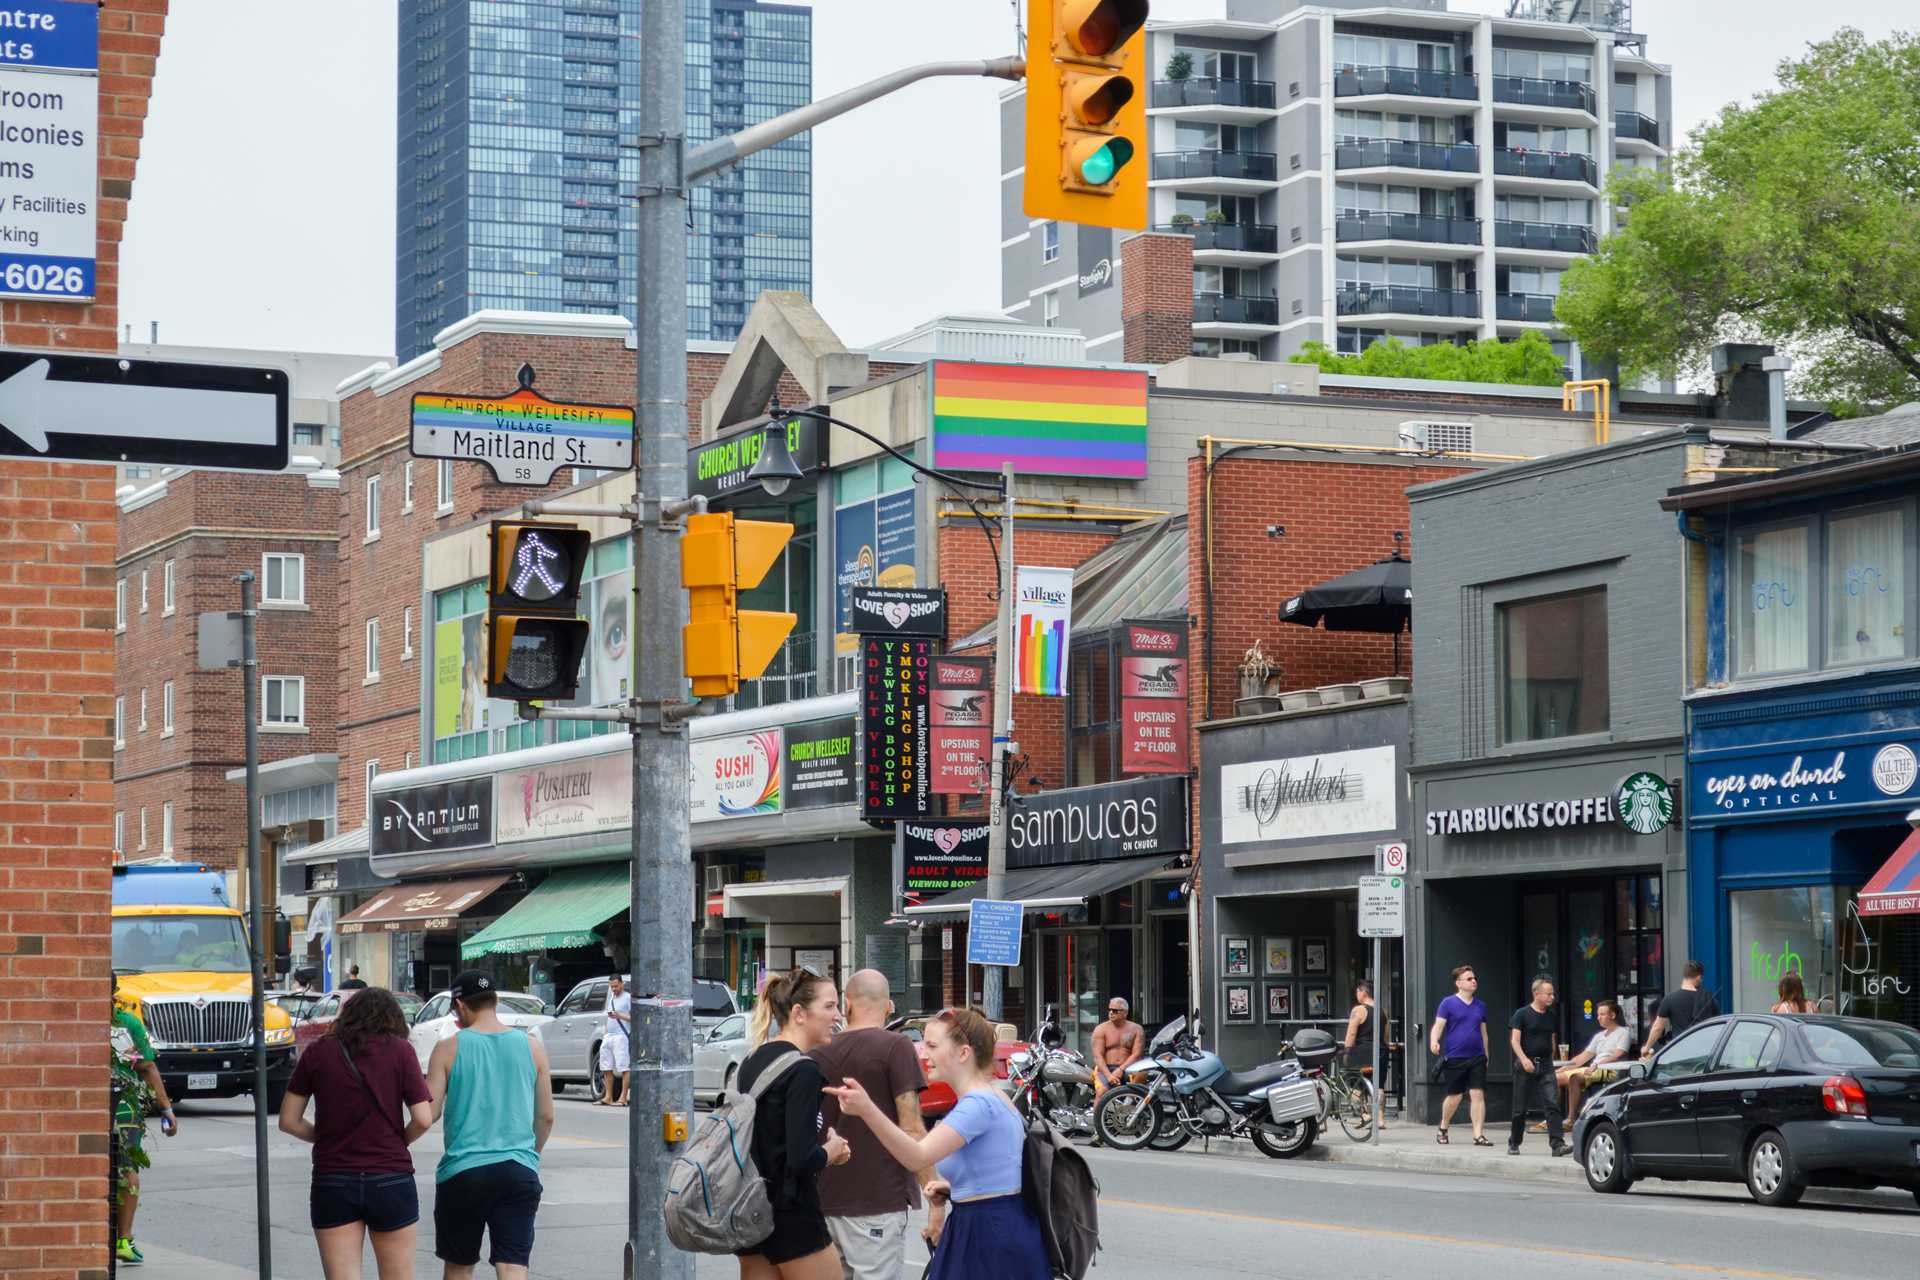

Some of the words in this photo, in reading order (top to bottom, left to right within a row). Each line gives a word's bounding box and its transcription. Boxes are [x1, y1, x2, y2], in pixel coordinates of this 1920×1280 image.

[13, 195, 87, 215] Facilities
[496, 418, 552, 433] VILLAGE
[453, 430, 554, 461] Maitland
[565, 438, 592, 464] St.
[698, 440, 739, 481] CHURCH
[515, 468, 531, 480] 58
[855, 597, 884, 616] LOVE
[910, 600, 940, 618] SHOP
[915, 643, 927, 696] TOYS
[883, 642, 896, 727] VIEWING
[900, 643, 912, 734] SMOKING
[1134, 711, 1176, 723] UPSTAIRS
[1139, 727, 1153, 737] ON
[1153, 727, 1171, 737] THE
[791, 742, 815, 761] CHURCH
[815, 736, 851, 758] WELLESLEY
[941, 739, 980, 749] UPSTAIRS
[1148, 741, 1176, 752] FLOOR
[917, 704, 927, 812] www.loveshoponline.ca
[946, 752, 957, 762] ON
[959, 752, 975, 762] THE
[1877, 760, 1893, 774] ALL
[1894, 758, 1912, 772] THE
[715, 754, 754, 779] SUSHI
[885, 735, 896, 807] BOOTHS
[901, 741, 912, 793] SHOP
[535, 771, 592, 803] PUSATERI
[1706, 774, 1746, 805] eyes
[1750, 772, 1778, 791] on
[1780, 752, 1847, 789] church
[1885, 772, 1907, 787] BEST
[1725, 791, 1837, 809] OPTICAL
[1426, 801, 1539, 836] STARBUCKS
[905, 825, 934, 842] LOVE
[960, 825, 990, 843] SHOP
[1123, 841, 1132, 851] ON
[1134, 839, 1158, 850] CHURCH
[914, 854, 982, 862] www.loveshoponline.ca
[907, 866, 949, 877] ADULT
[908, 880, 949, 888] VIEWING
[1866, 900, 1879, 911] ALL
[1880, 899, 1896, 910] THE
[1898, 898, 1915, 909] BEST
